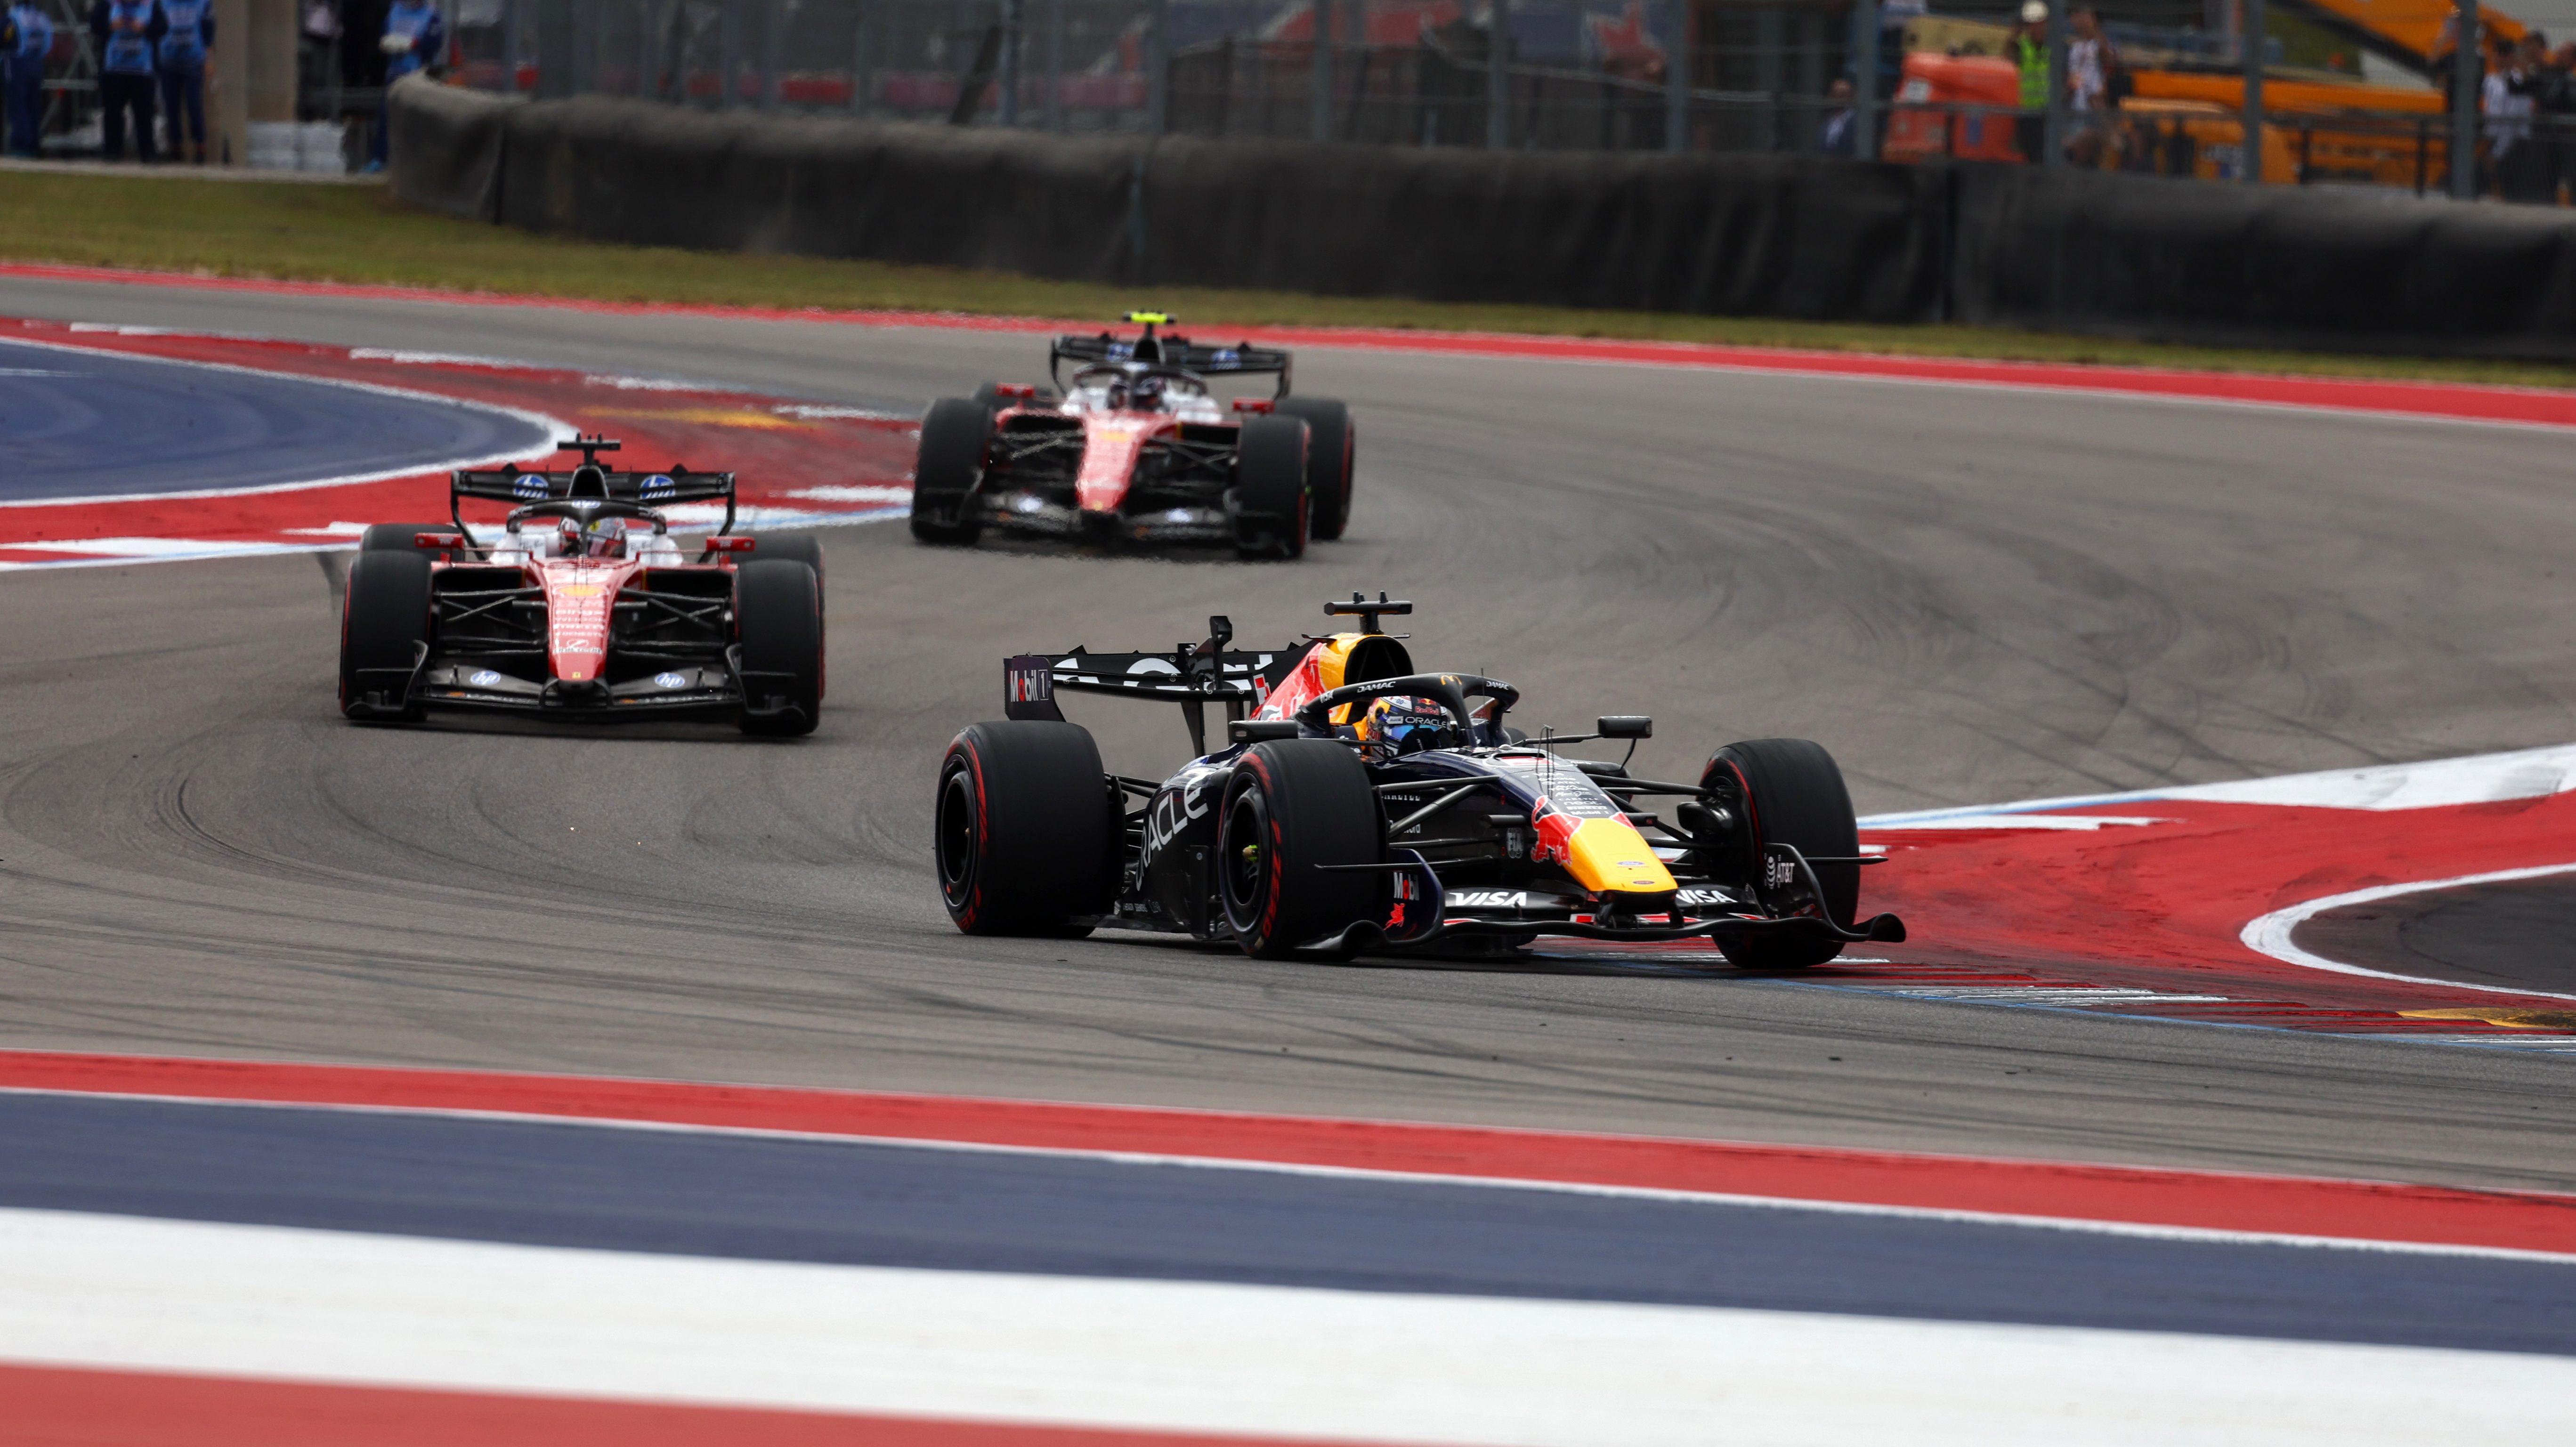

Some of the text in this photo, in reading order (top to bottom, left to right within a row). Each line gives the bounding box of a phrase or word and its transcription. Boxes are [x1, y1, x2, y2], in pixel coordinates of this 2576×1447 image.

[477, 671, 498, 686] hp
[660, 673, 682, 687] hp
[1010, 669, 1038, 702] Mobil
[1486, 681, 1509, 690] DAMAC
[1357, 681, 1396, 693] DAMAC
[1405, 717, 1447, 728] ORACLE
[1776, 862, 1795, 883] AT&T
[1449, 891, 1527, 906] VISA
[1676, 889, 1738, 904] VISA
